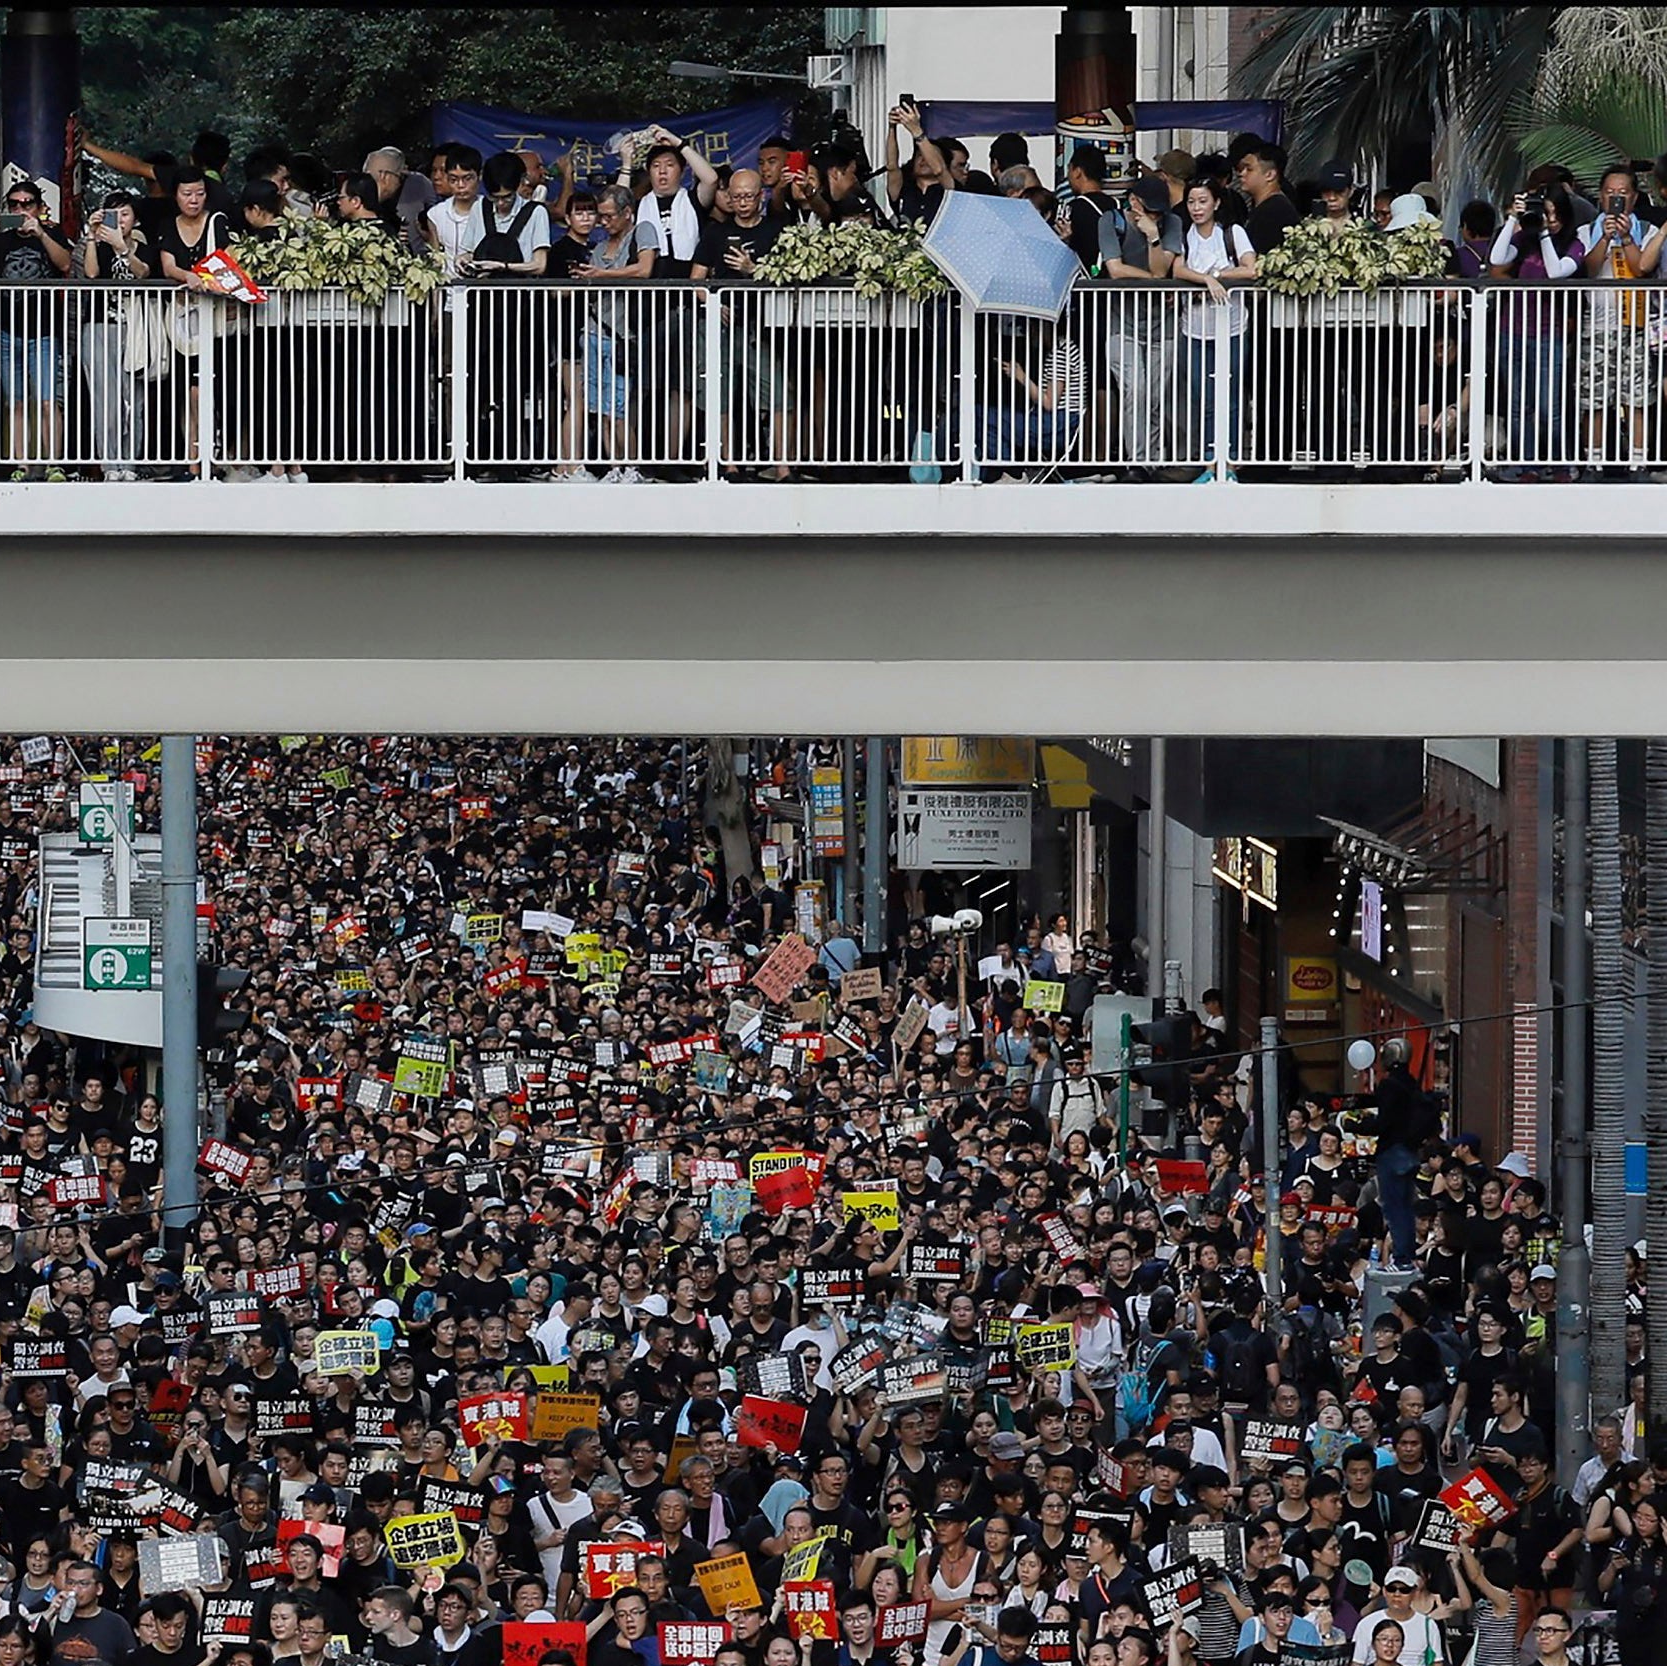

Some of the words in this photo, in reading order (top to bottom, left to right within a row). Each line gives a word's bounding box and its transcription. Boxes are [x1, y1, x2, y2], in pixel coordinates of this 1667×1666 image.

[961, 810, 977, 818] TOP
[130, 1136, 156, 1163] 23
[751, 1159, 787, 1172] STAND
[788, 1155, 804, 1168] UP
[1247, 1422, 1300, 1439] 獨立調查
[390, 1519, 454, 1542] 企硬立場
[206, 1601, 254, 1618] 獨立調查
